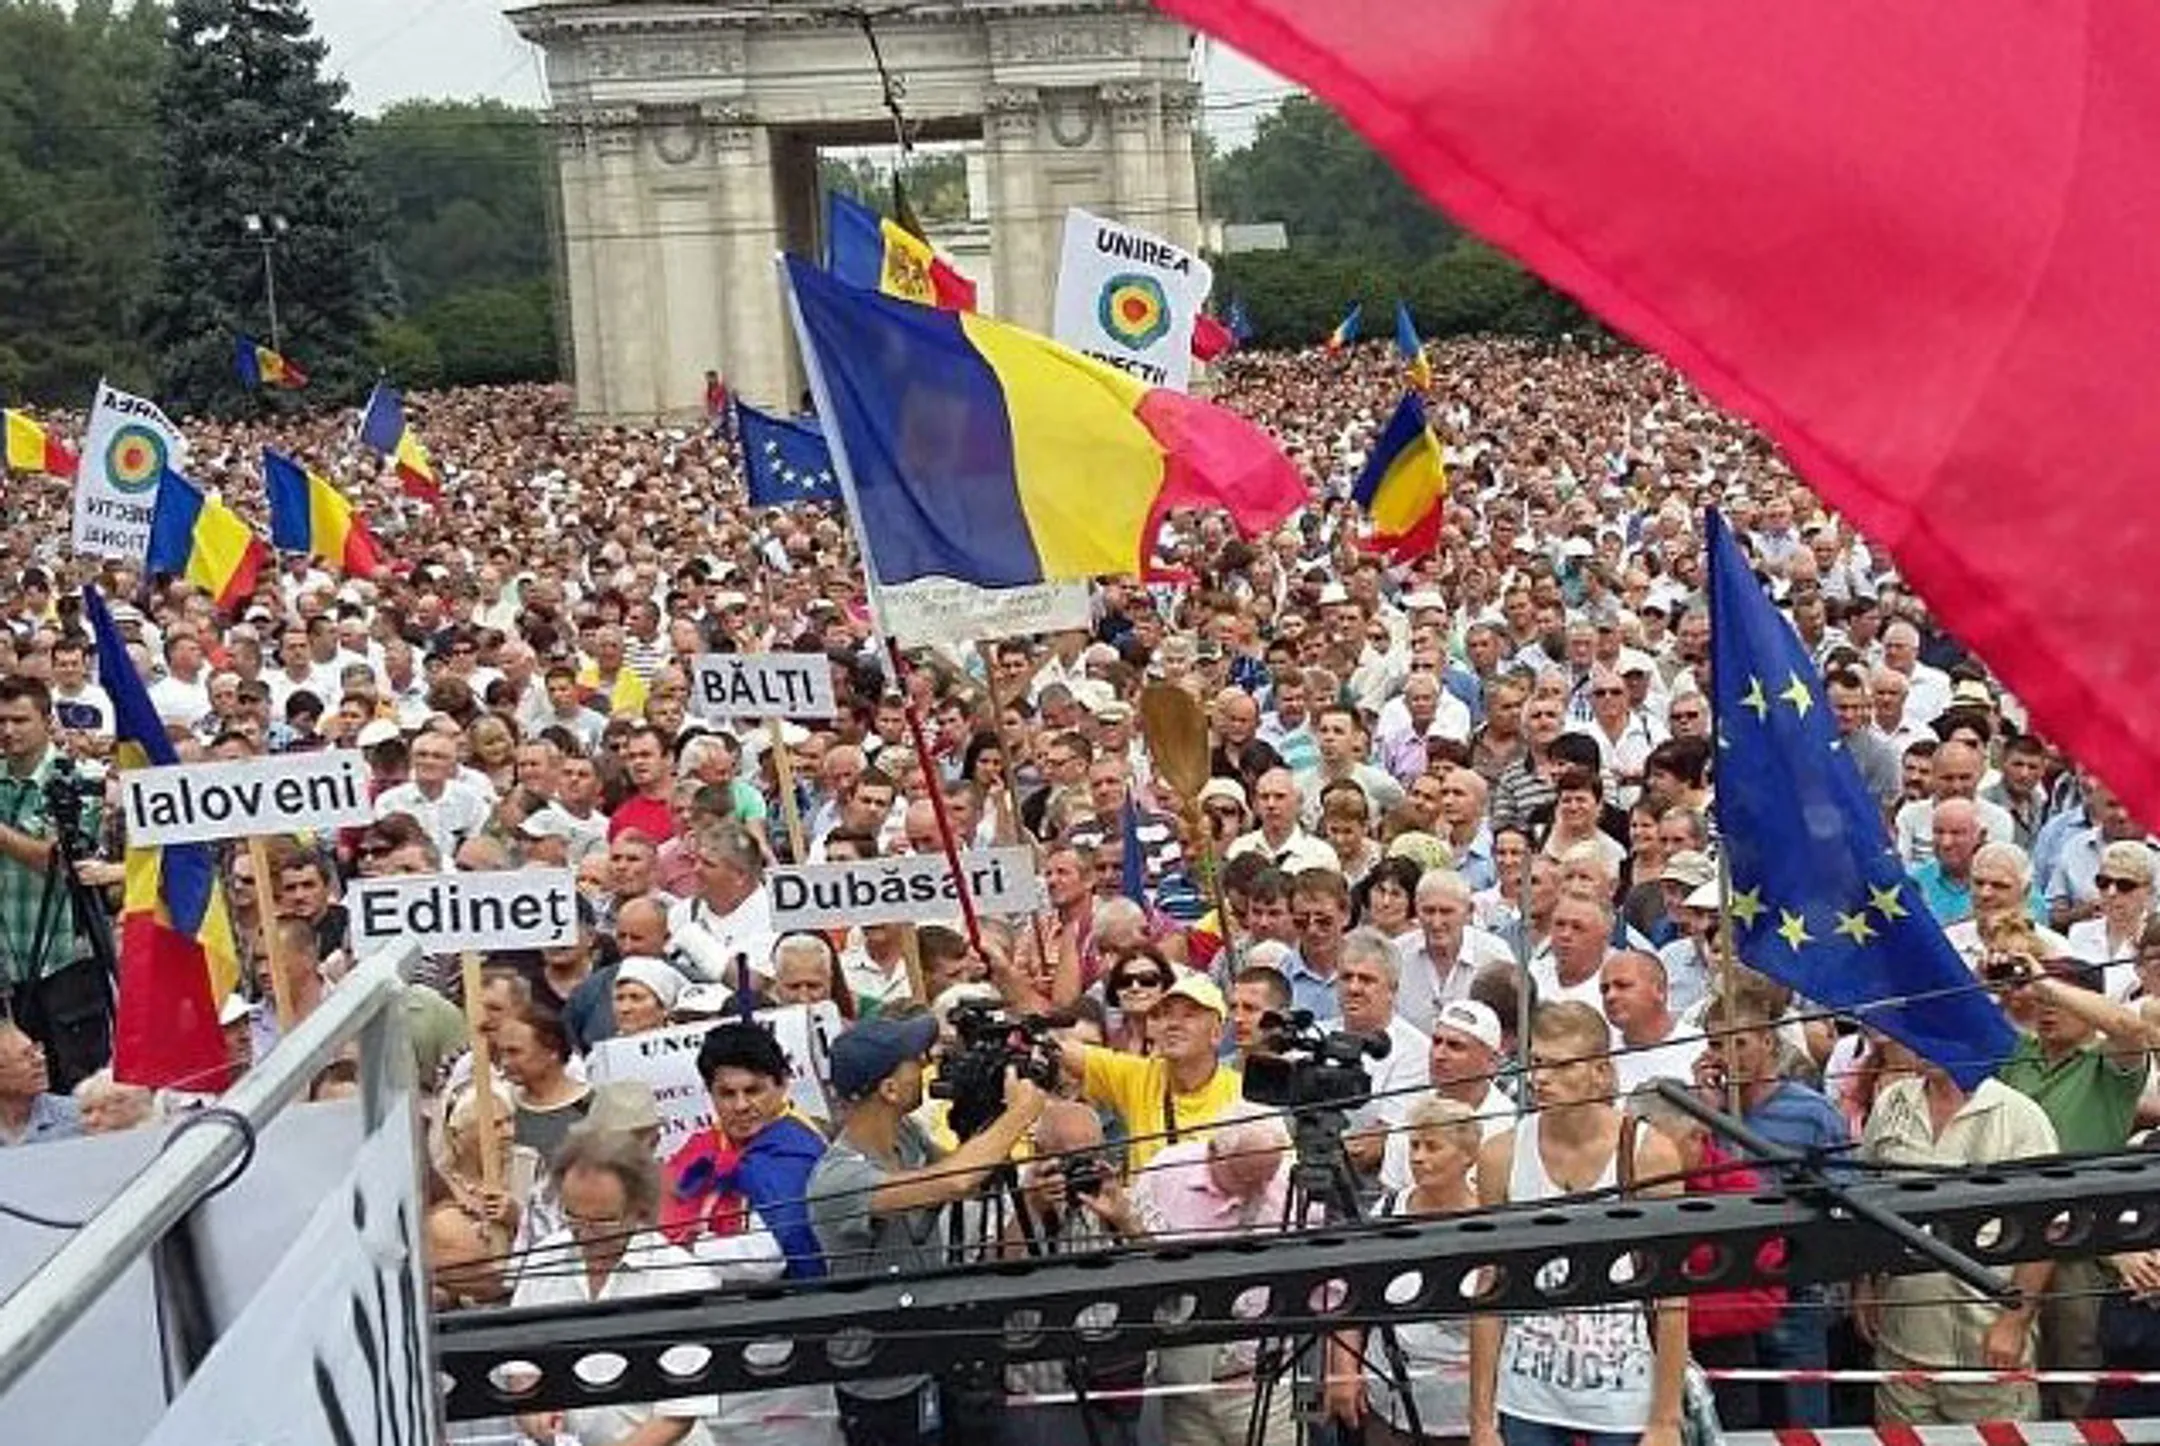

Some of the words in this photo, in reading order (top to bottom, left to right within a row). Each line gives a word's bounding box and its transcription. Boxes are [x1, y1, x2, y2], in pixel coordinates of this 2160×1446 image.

[1096, 227, 1190, 275] UNIREA
[131, 761, 357, 828] Ialoveni
[361, 885, 569, 940] Edineț
